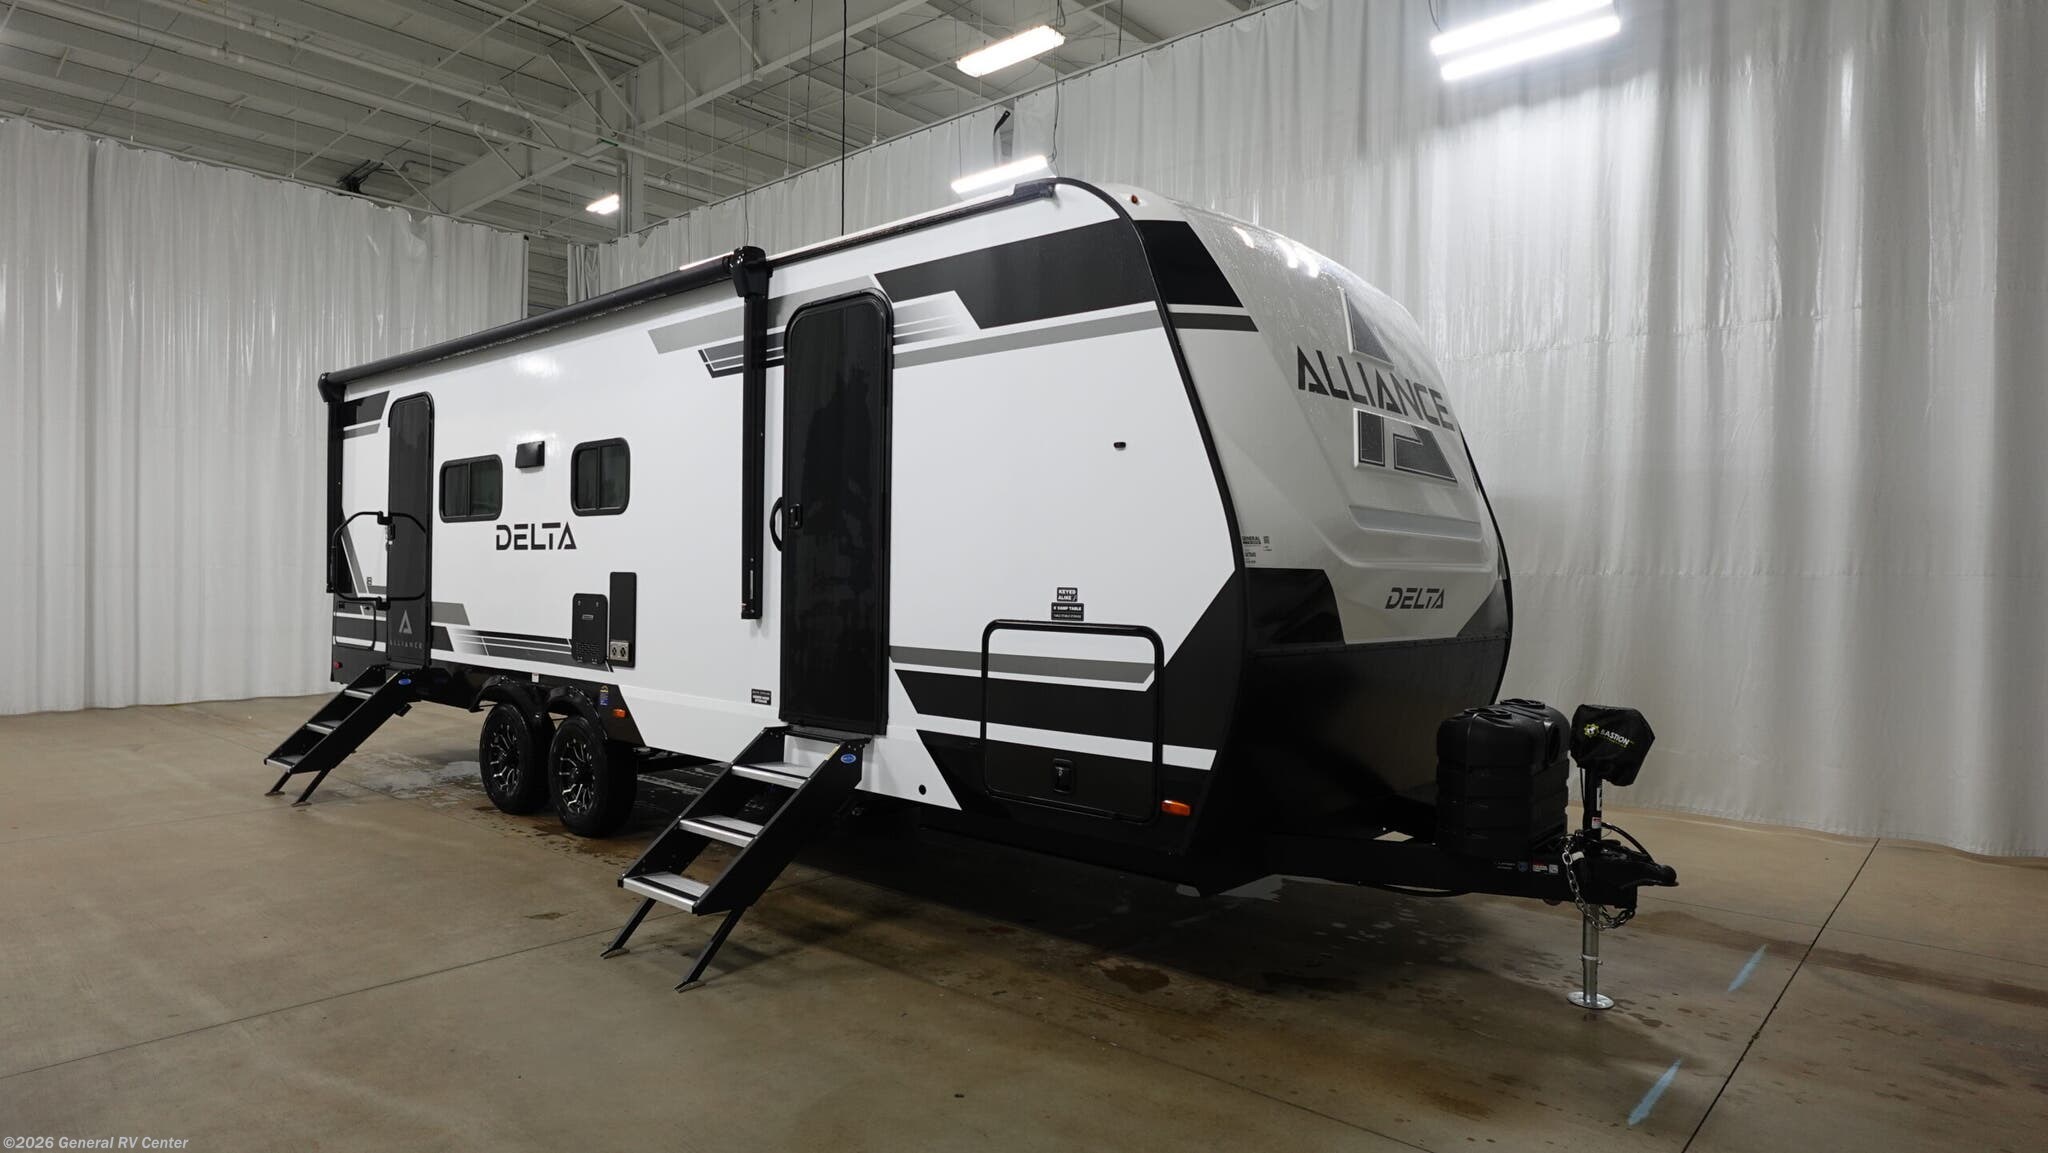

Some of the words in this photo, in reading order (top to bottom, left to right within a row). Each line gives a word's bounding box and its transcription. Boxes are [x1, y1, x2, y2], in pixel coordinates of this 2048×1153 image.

[1297, 345, 1456, 432] ALLIANCE
[496, 522, 577, 551] DELTA
[1385, 587, 1446, 609] DELTA
